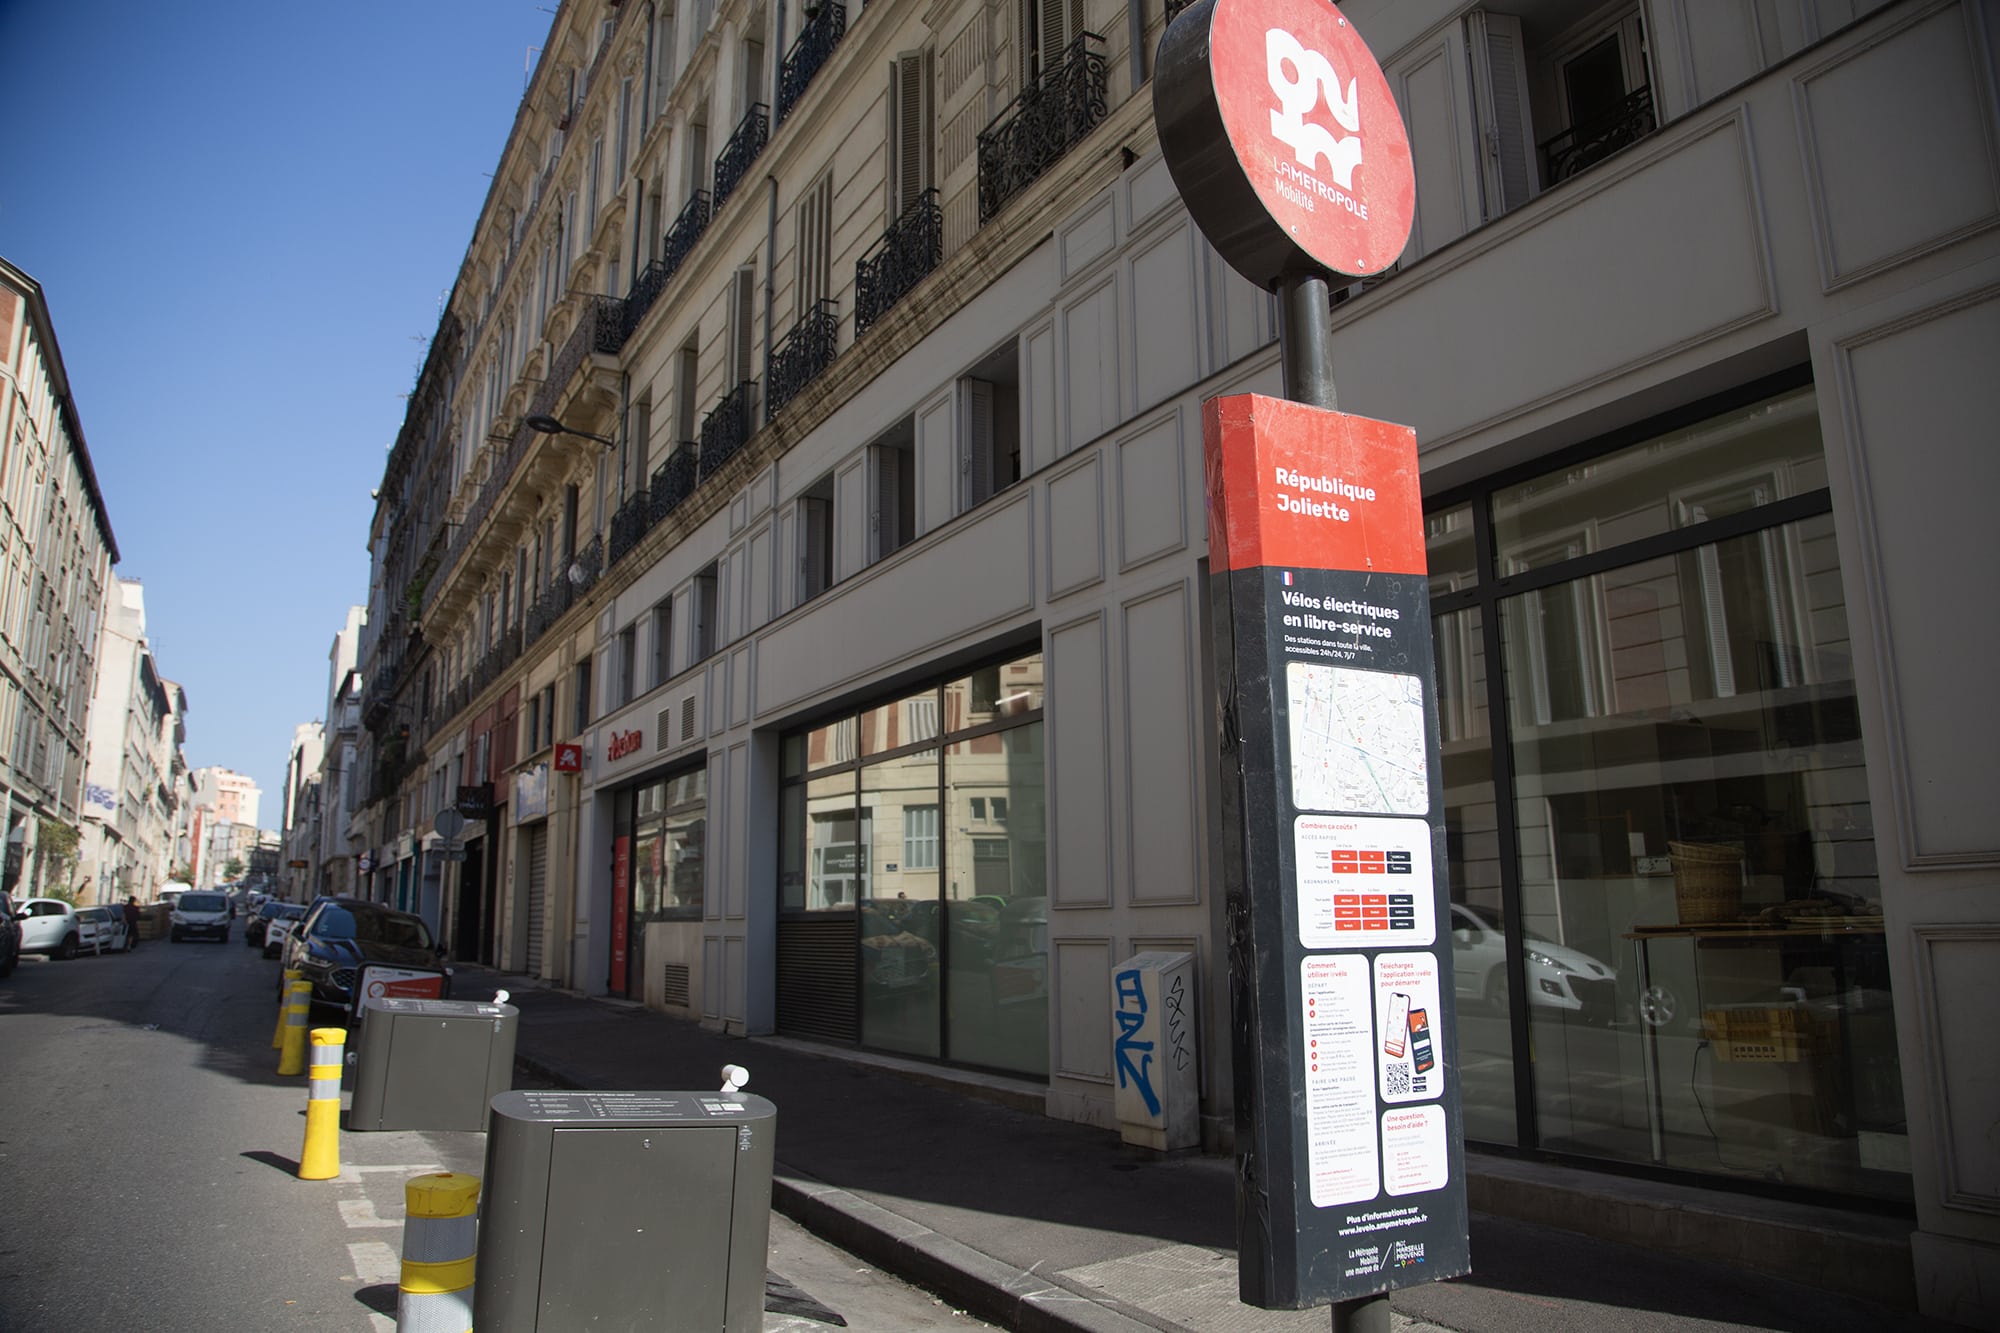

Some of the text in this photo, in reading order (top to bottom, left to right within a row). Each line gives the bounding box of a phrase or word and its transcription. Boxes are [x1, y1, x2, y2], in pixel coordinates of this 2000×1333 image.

[1276, 180, 1314, 211] Mobilité
[1276, 468, 1375, 501] République
[1278, 494, 1349, 522] Joliette
[1282, 591, 1400, 620] Vélos électriques
[1283, 614, 1391, 638] en libre-service
[1284, 635, 1296, 643] Des
[1297, 636, 1321, 646] stations
[1322, 639, 1336, 647] dans
[1337, 641, 1352, 649] toute
[1285, 646, 1319, 655] accessibles
[1336, 822, 1352, 830] coûte
[1381, 980, 1394, 988] pour
[1346, 1206, 1418, 1224] Plus d'informations sur
[1339, 1215, 1428, 1236] www.levelo.ampmetropole.fr
[1348, 1246, 1378, 1259] La Métropole
[1396, 1243, 1424, 1254] MARSEILLE
[1360, 1256, 1379, 1266] Mobilité
[1396, 1250, 1424, 1261] PROVENCE
[1345, 1264, 1379, 1277] une marque de
